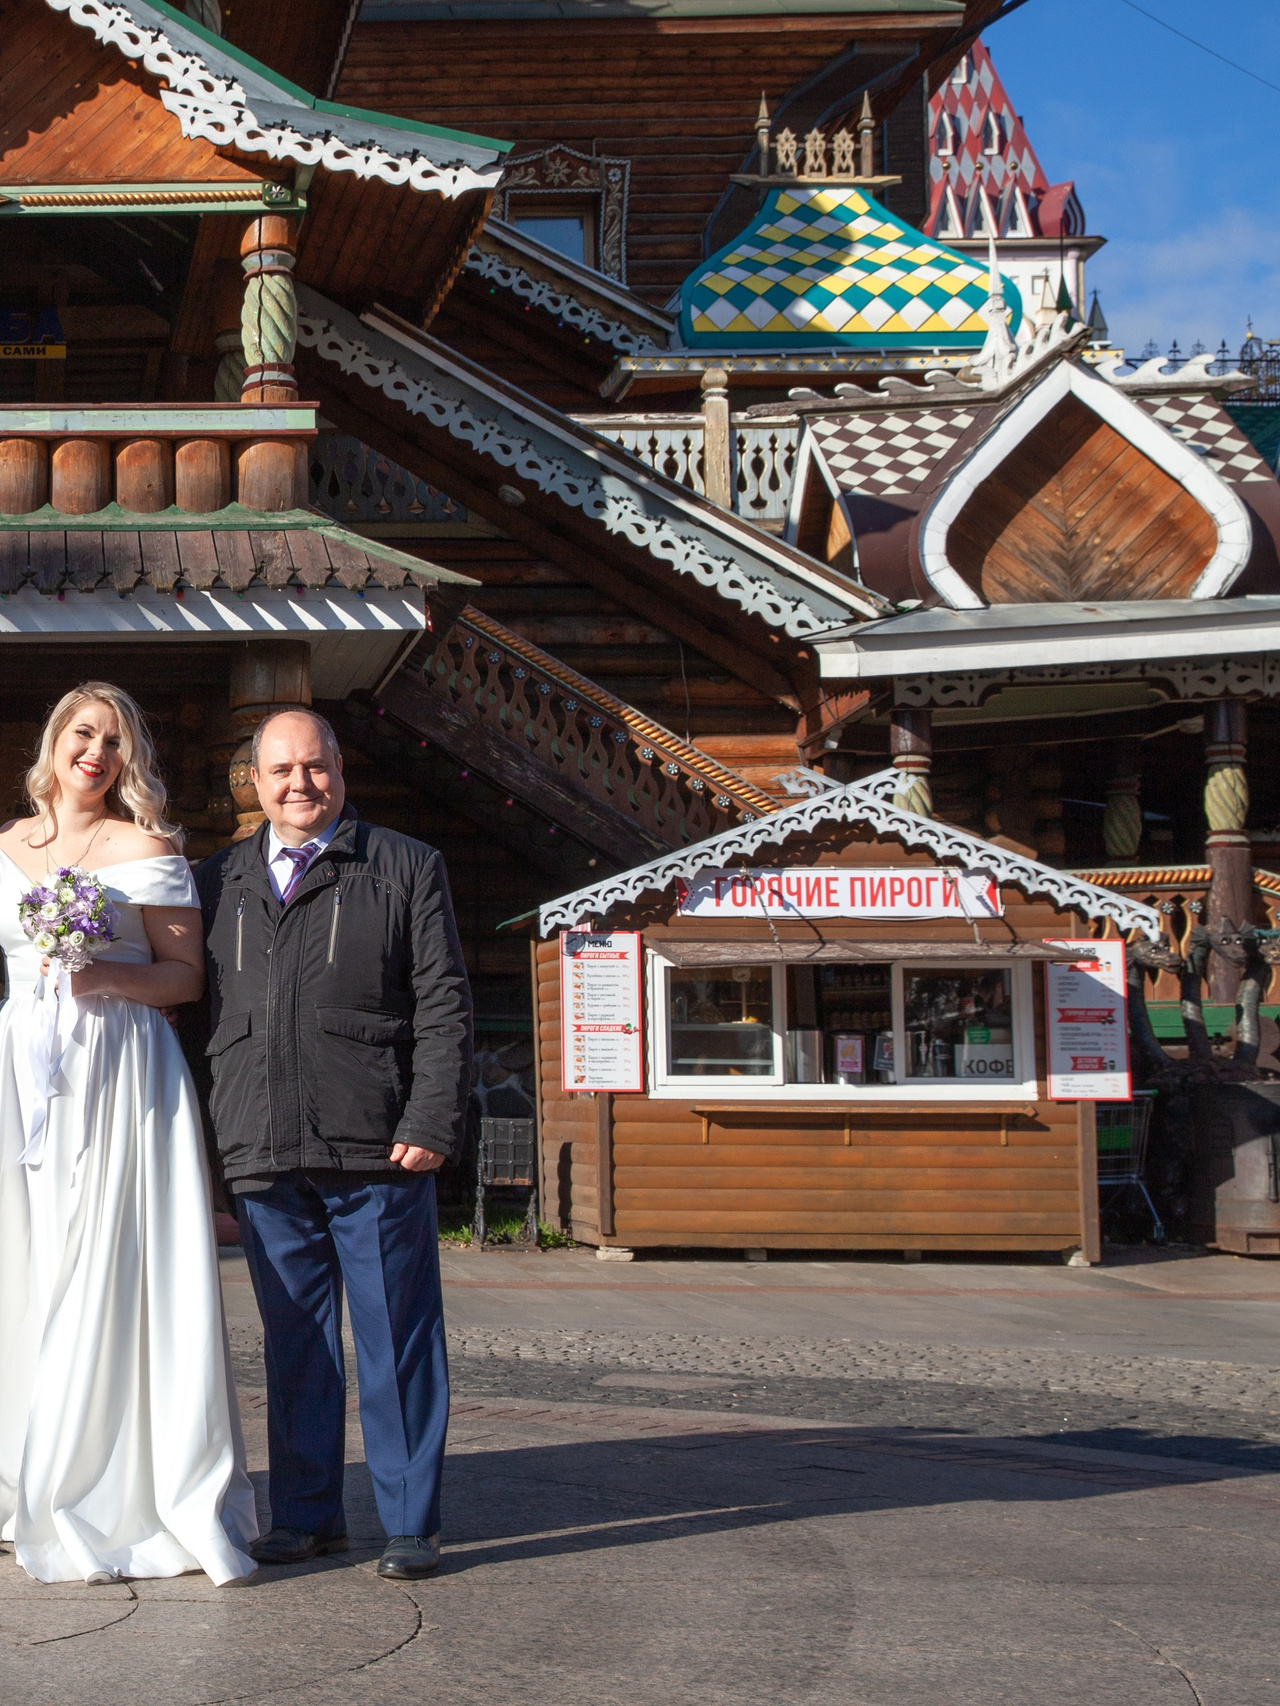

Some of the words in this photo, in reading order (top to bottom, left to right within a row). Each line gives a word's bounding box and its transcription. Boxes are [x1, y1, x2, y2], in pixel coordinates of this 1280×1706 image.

[2, 346, 47, 356] САМИ
[714, 876, 840, 907] ГОРЯЧИЕ
[850, 877, 959, 908] ПИРОГИ
[587, 940, 613, 948] МЕНЮ
